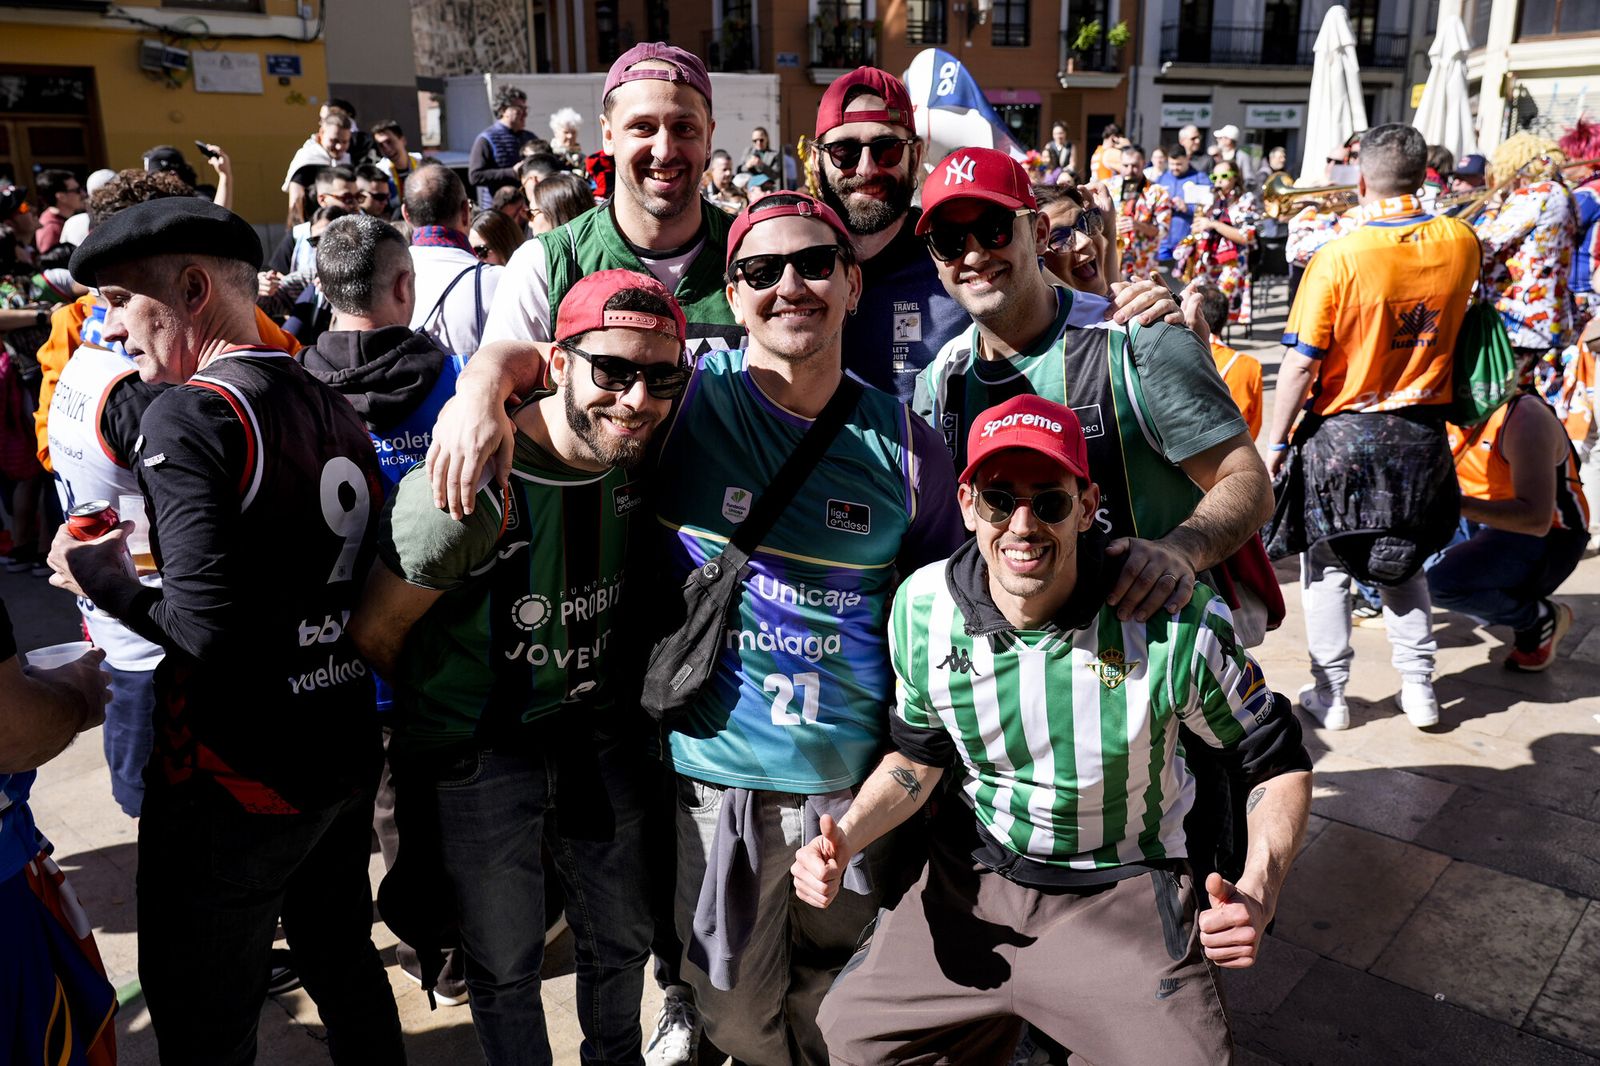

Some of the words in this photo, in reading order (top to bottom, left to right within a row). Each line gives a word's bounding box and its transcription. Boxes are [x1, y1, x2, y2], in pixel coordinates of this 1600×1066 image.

[893, 302, 920, 312] TRAVEL
[892, 346, 910, 354] LET'S
[892, 353, 908, 361] JUST
[981, 412, 1063, 438] Sporeme
[319, 456, 370, 584] 9
[830, 508, 849, 519] liga
[830, 519, 868, 532] endesa
[758, 575, 861, 614] Unicaja
[763, 671, 820, 726] 27
[1159, 976, 1180, 991] NIKE
